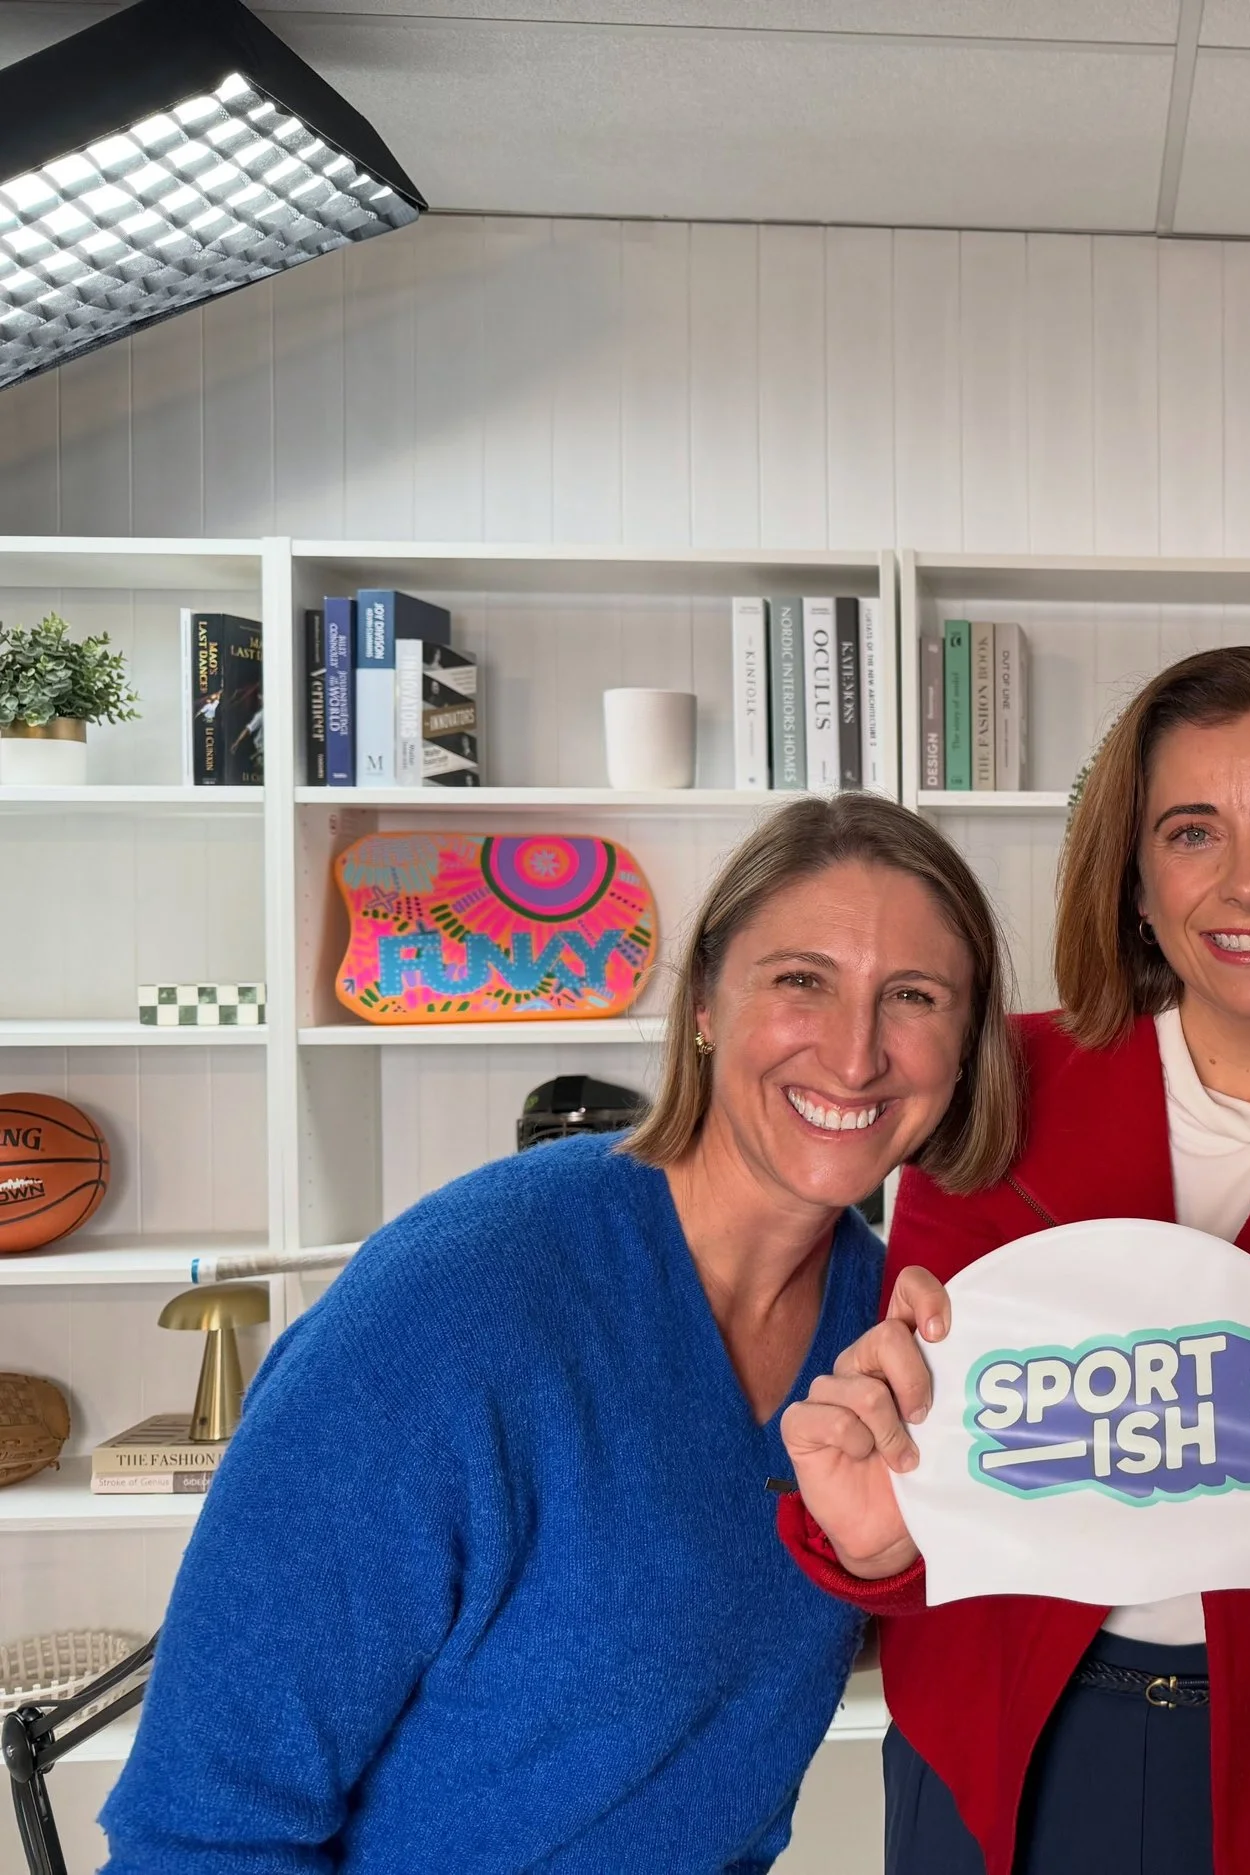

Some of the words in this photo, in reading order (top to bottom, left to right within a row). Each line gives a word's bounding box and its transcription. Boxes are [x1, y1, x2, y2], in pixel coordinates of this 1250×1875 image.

[374, 602, 385, 621] JOY
[198, 621, 208, 647] LAST
[373, 621, 386, 660] DIVISION
[781, 606, 793, 659] NORDIC
[199, 650, 209, 693] DANCER
[208, 642, 218, 675] MAO'S
[841, 641, 855, 683] KATE
[978, 636, 989, 680] BOOK
[1002, 650, 1010, 671] OUT
[745, 651, 757, 717] KINFOLK
[782, 662, 796, 732] INTERIORS
[813, 629, 831, 730] OCULUS
[1002, 672, 1010, 687] OF
[1002, 689, 1010, 710] LINE
[310, 668, 328, 742] Vermeer
[328, 686, 340, 732] WORLD
[430, 707, 475, 731] INNOVATORS
[842, 684, 856, 724] MOSS
[868, 688, 877, 739] ARCHITECTURE
[978, 685, 989, 748] FASHION
[366, 755, 383, 770] M
[784, 733, 797, 783] HOMES
[927, 733, 939, 786] DESIGN
[978, 752, 989, 783] THE
[0, 1127, 42, 1151] NG
[977, 1335, 1227, 1429] SPORT
[116, 1454, 148, 1466] THE
[151, 1453, 215, 1466] FASHION
[98, 1478, 126, 1487] Stroke
[127, 1478, 138, 1487] of
[140, 1478, 170, 1487] Genius
